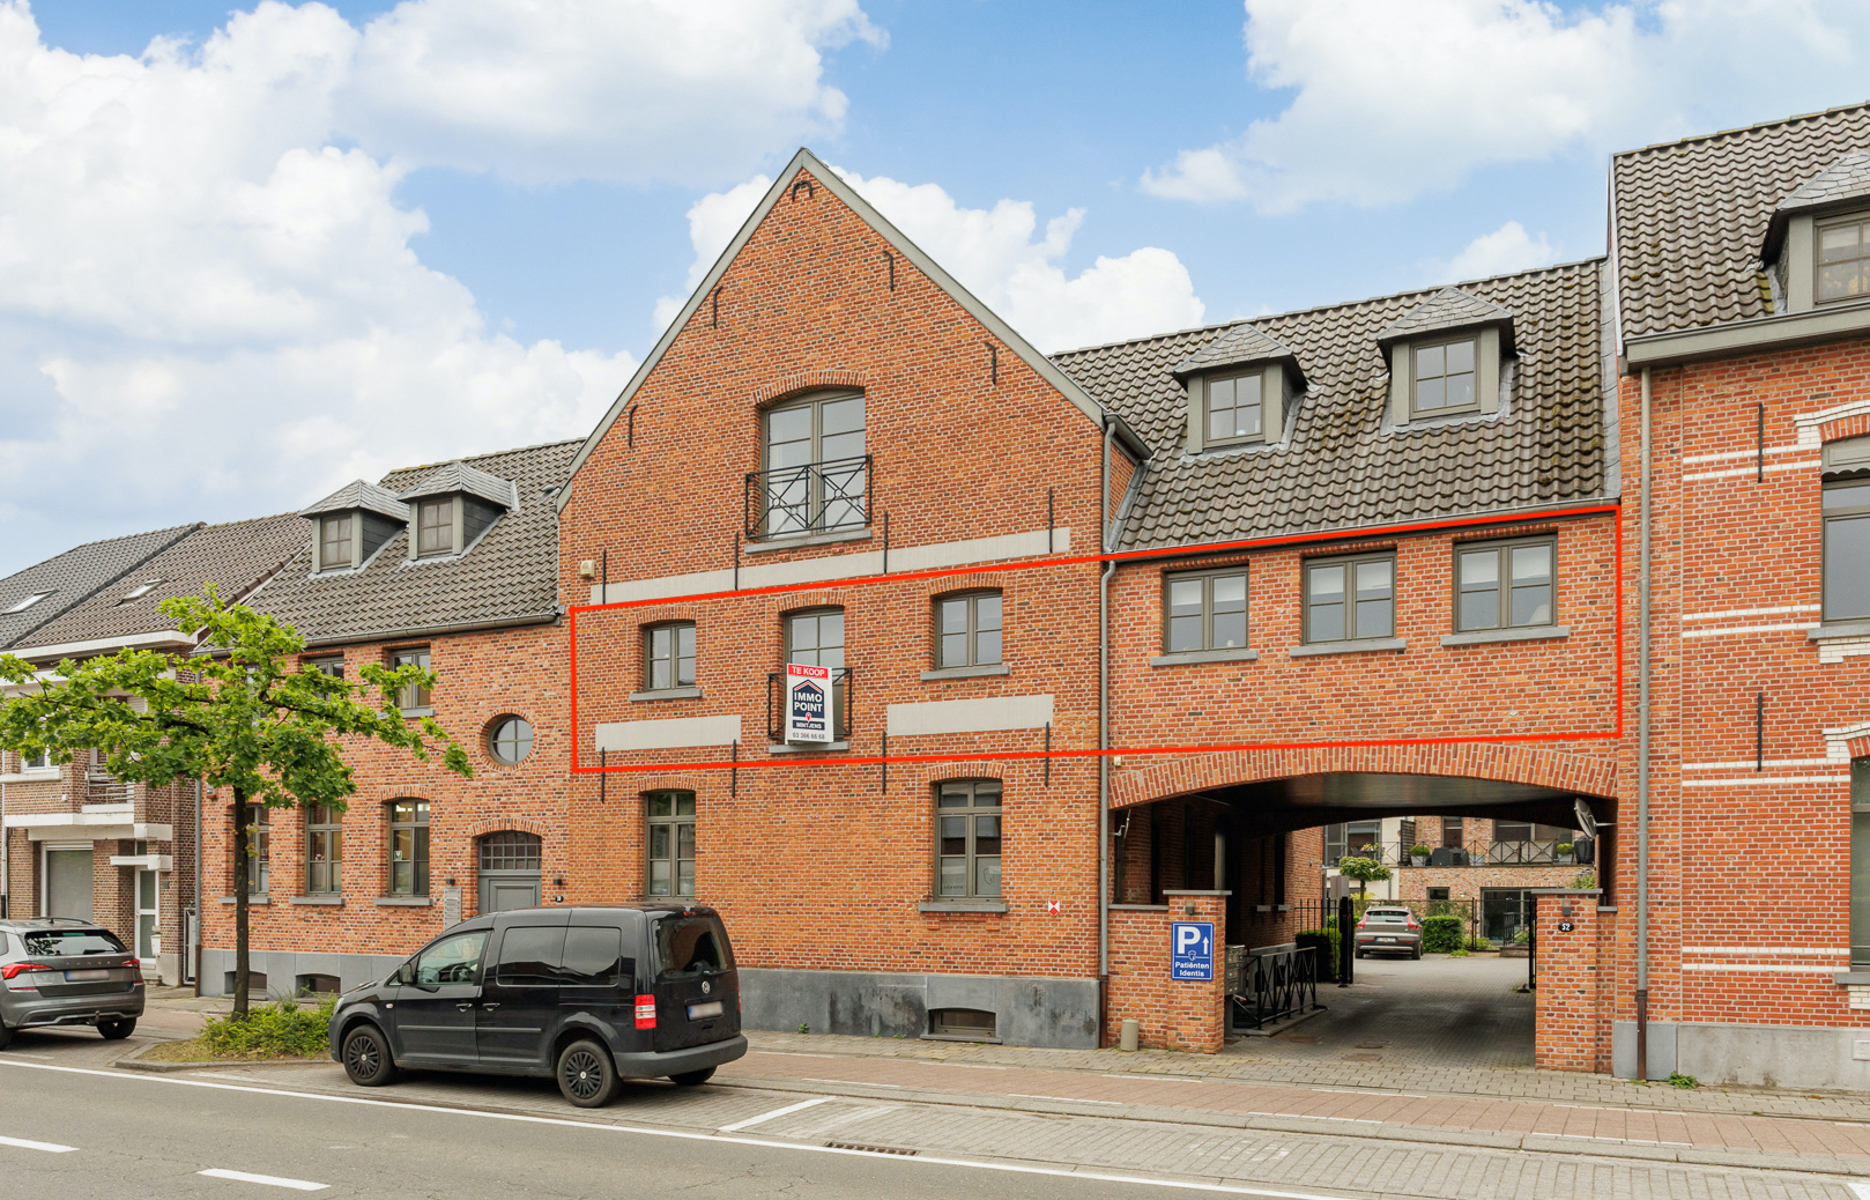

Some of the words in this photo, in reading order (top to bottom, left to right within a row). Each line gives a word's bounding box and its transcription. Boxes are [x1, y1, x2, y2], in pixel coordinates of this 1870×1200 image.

[791, 666, 802, 675] TE
[803, 667, 825, 677] KOOP
[794, 692, 823, 703] IMMO
[794, 702, 823, 712] POINT
[1562, 923, 1571, 931] 52
[1178, 926, 1201, 954] P
[1175, 961, 1210, 969] Patiënten
[1180, 969, 1205, 977] Identis
